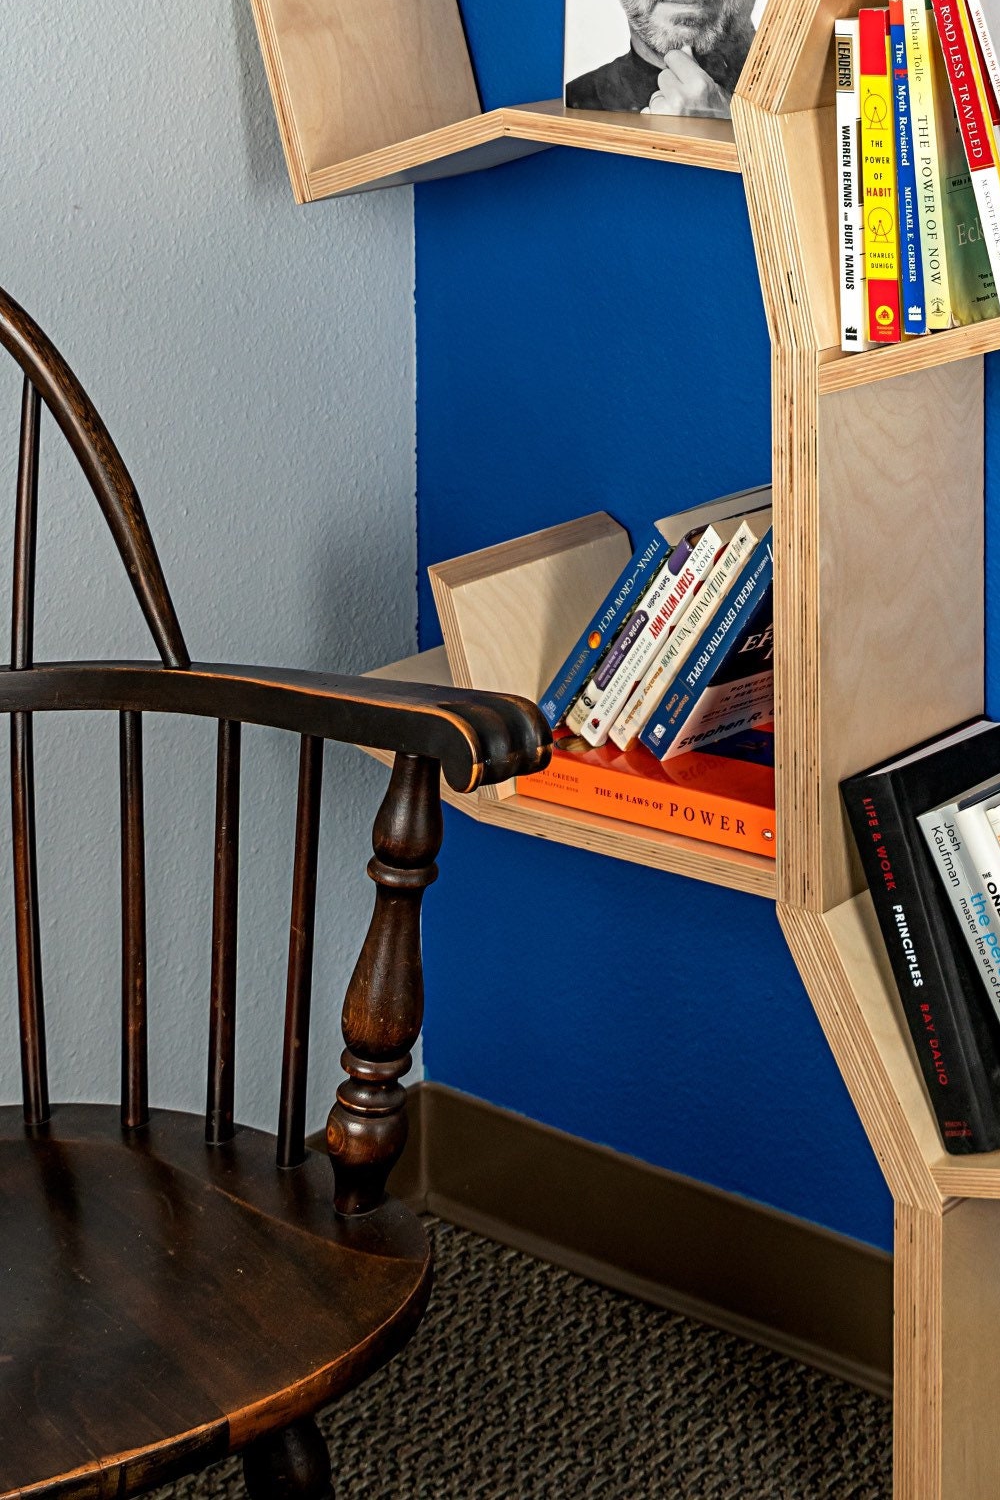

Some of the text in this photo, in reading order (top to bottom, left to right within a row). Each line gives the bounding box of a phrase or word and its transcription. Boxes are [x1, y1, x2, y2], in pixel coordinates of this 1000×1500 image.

[909, 8, 920, 51] Eckhart
[838, 41, 851, 87] LEADERS
[914, 55, 924, 82] Tolle
[940, 6, 957, 42] ROAD
[949, 45, 965, 79] LESS
[958, 84, 983, 159] TRAVELED
[871, 140, 883, 148] THE
[918, 115, 930, 148] THE
[866, 188, 892, 197] HABIT
[920, 157, 935, 214] POWER
[926, 221, 938, 240] OF
[928, 248, 943, 286] NOW
[689, 538, 708, 564] SINEK
[695, 545, 716, 575] SIMON
[648, 568, 695, 640] START WITH WHY
[594, 786, 746, 836] THE 48 LAWS OF POWER
[944, 822, 962, 852] Josh
[931, 826, 961, 888] Kaufman
[970, 891, 991, 927] the
[862, 798, 880, 827] LIFE
[876, 845, 897, 891] WORK
[893, 904, 923, 987] PRINCIPLES
[920, 1003, 935, 1032] RAY
[929, 1038, 948, 1086] DALIO
[959, 897, 979, 935] master
[975, 938, 985, 956] the
[982, 958, 995, 974] art
